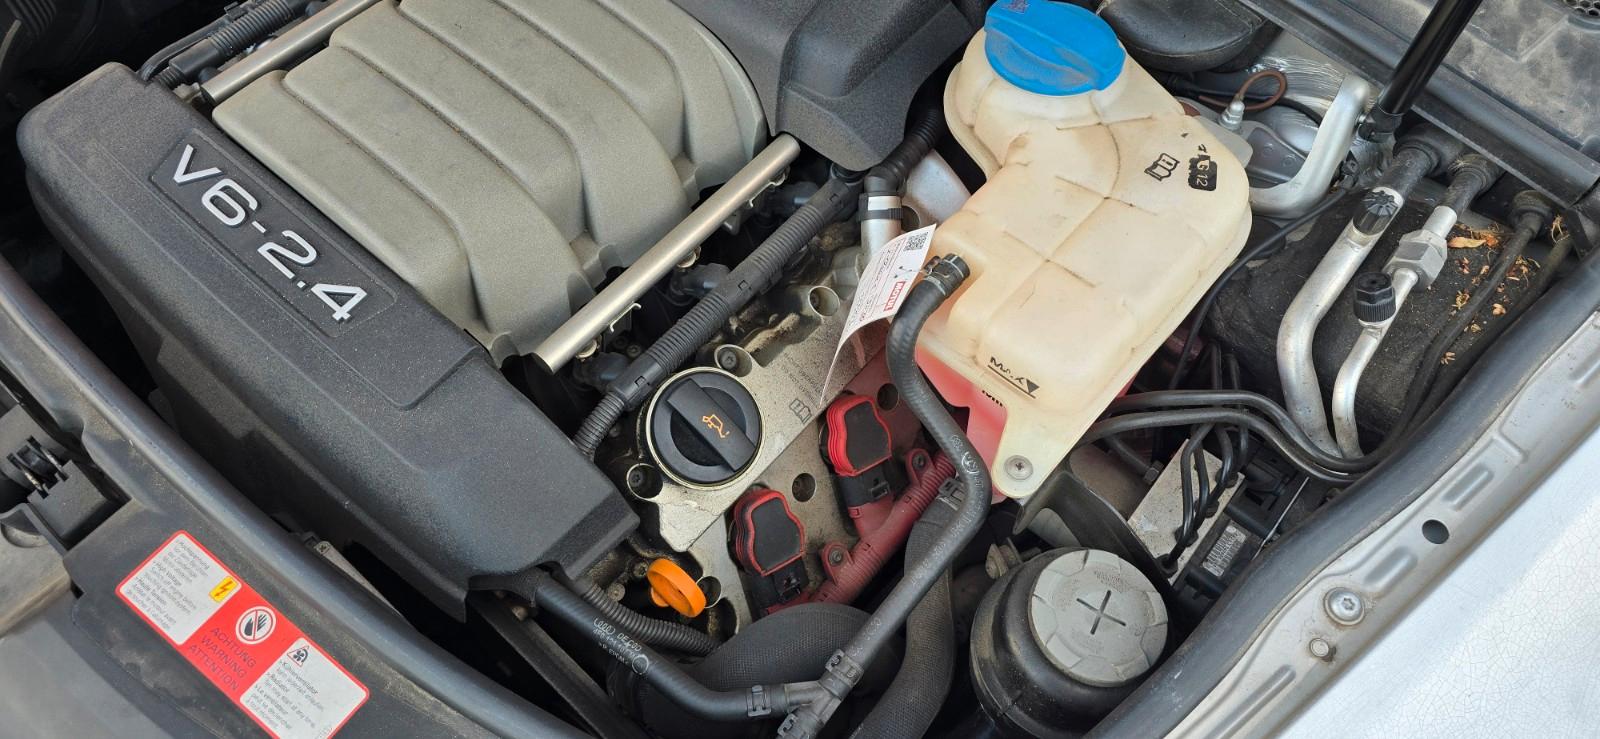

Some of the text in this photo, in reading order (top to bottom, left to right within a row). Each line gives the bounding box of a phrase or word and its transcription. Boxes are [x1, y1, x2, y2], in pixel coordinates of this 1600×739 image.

[173, 144, 368, 321] V6-2.4
[885, 281, 905, 311] MOTUL
[189, 644, 240, 691] ATTENTION
[202, 635, 247, 678] WARNING
[210, 627, 256, 668] ACHTUNG
